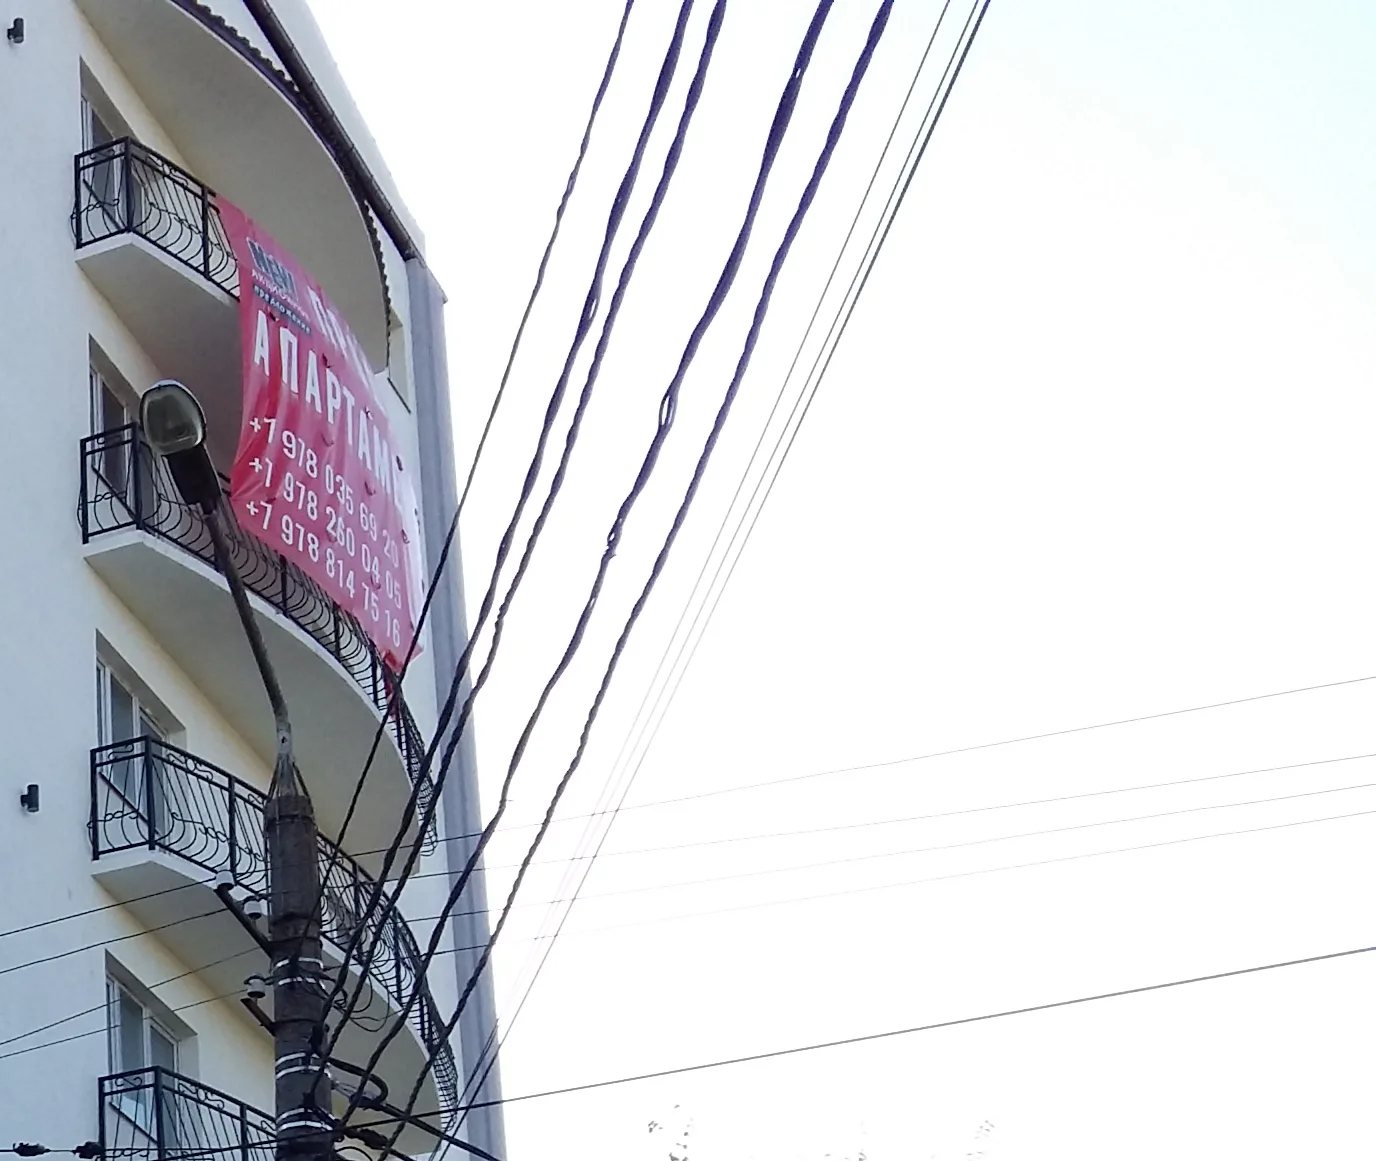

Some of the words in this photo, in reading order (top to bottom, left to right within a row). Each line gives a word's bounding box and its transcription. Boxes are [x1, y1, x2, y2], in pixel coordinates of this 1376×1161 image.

[249, 416, 276, 444] +7
[282, 430, 317, 478] 978
[325, 464, 354, 515] 035
[360, 502, 377, 541] 69
[249, 457, 273, 487] +7
[284, 472, 317, 520] 978
[325, 506, 355, 556] 260
[362, 544, 380, 585] 04
[385, 570, 401, 609] 05
[246, 500, 272, 530] +7
[281, 515, 318, 563] 978
[362, 583, 379, 622] 75
